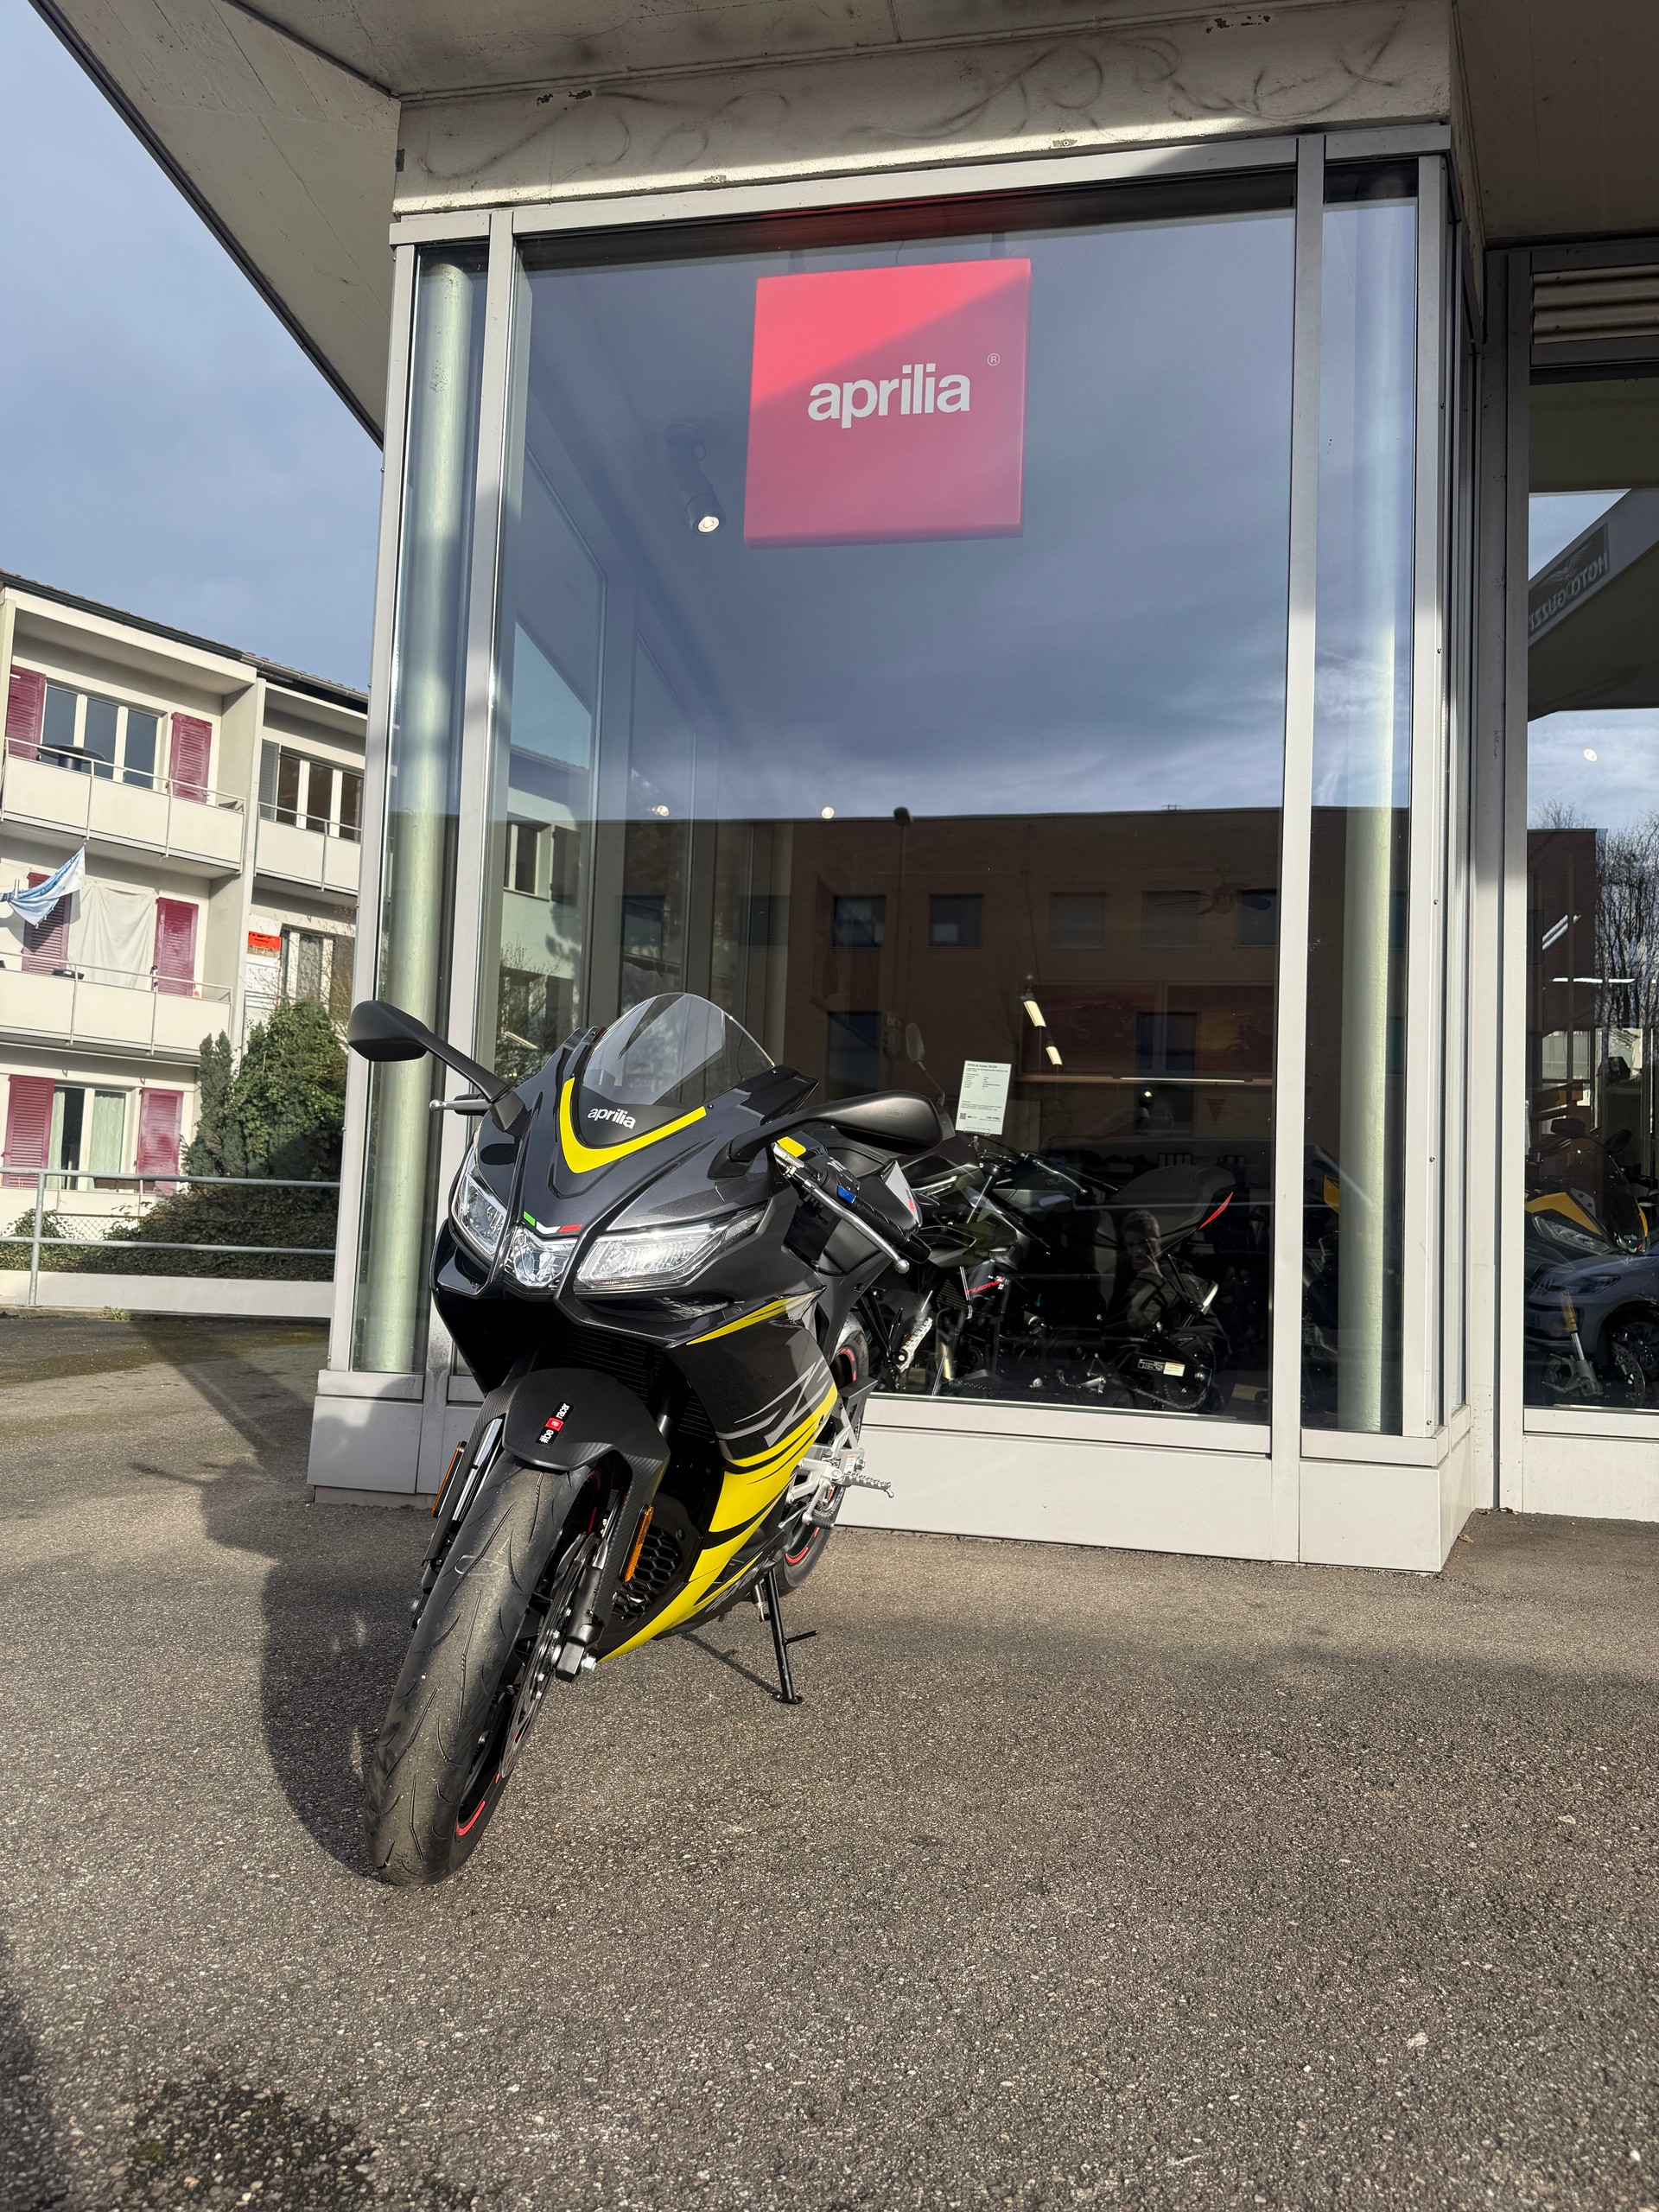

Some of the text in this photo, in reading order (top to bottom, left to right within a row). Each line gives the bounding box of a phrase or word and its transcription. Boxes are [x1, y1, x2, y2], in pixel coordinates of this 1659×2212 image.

[808, 363, 970, 429] aprilia
[587, 1108, 637, 1129] aprilia
[538, 1429, 554, 1444] #be
[556, 1402, 570, 1420] racer
